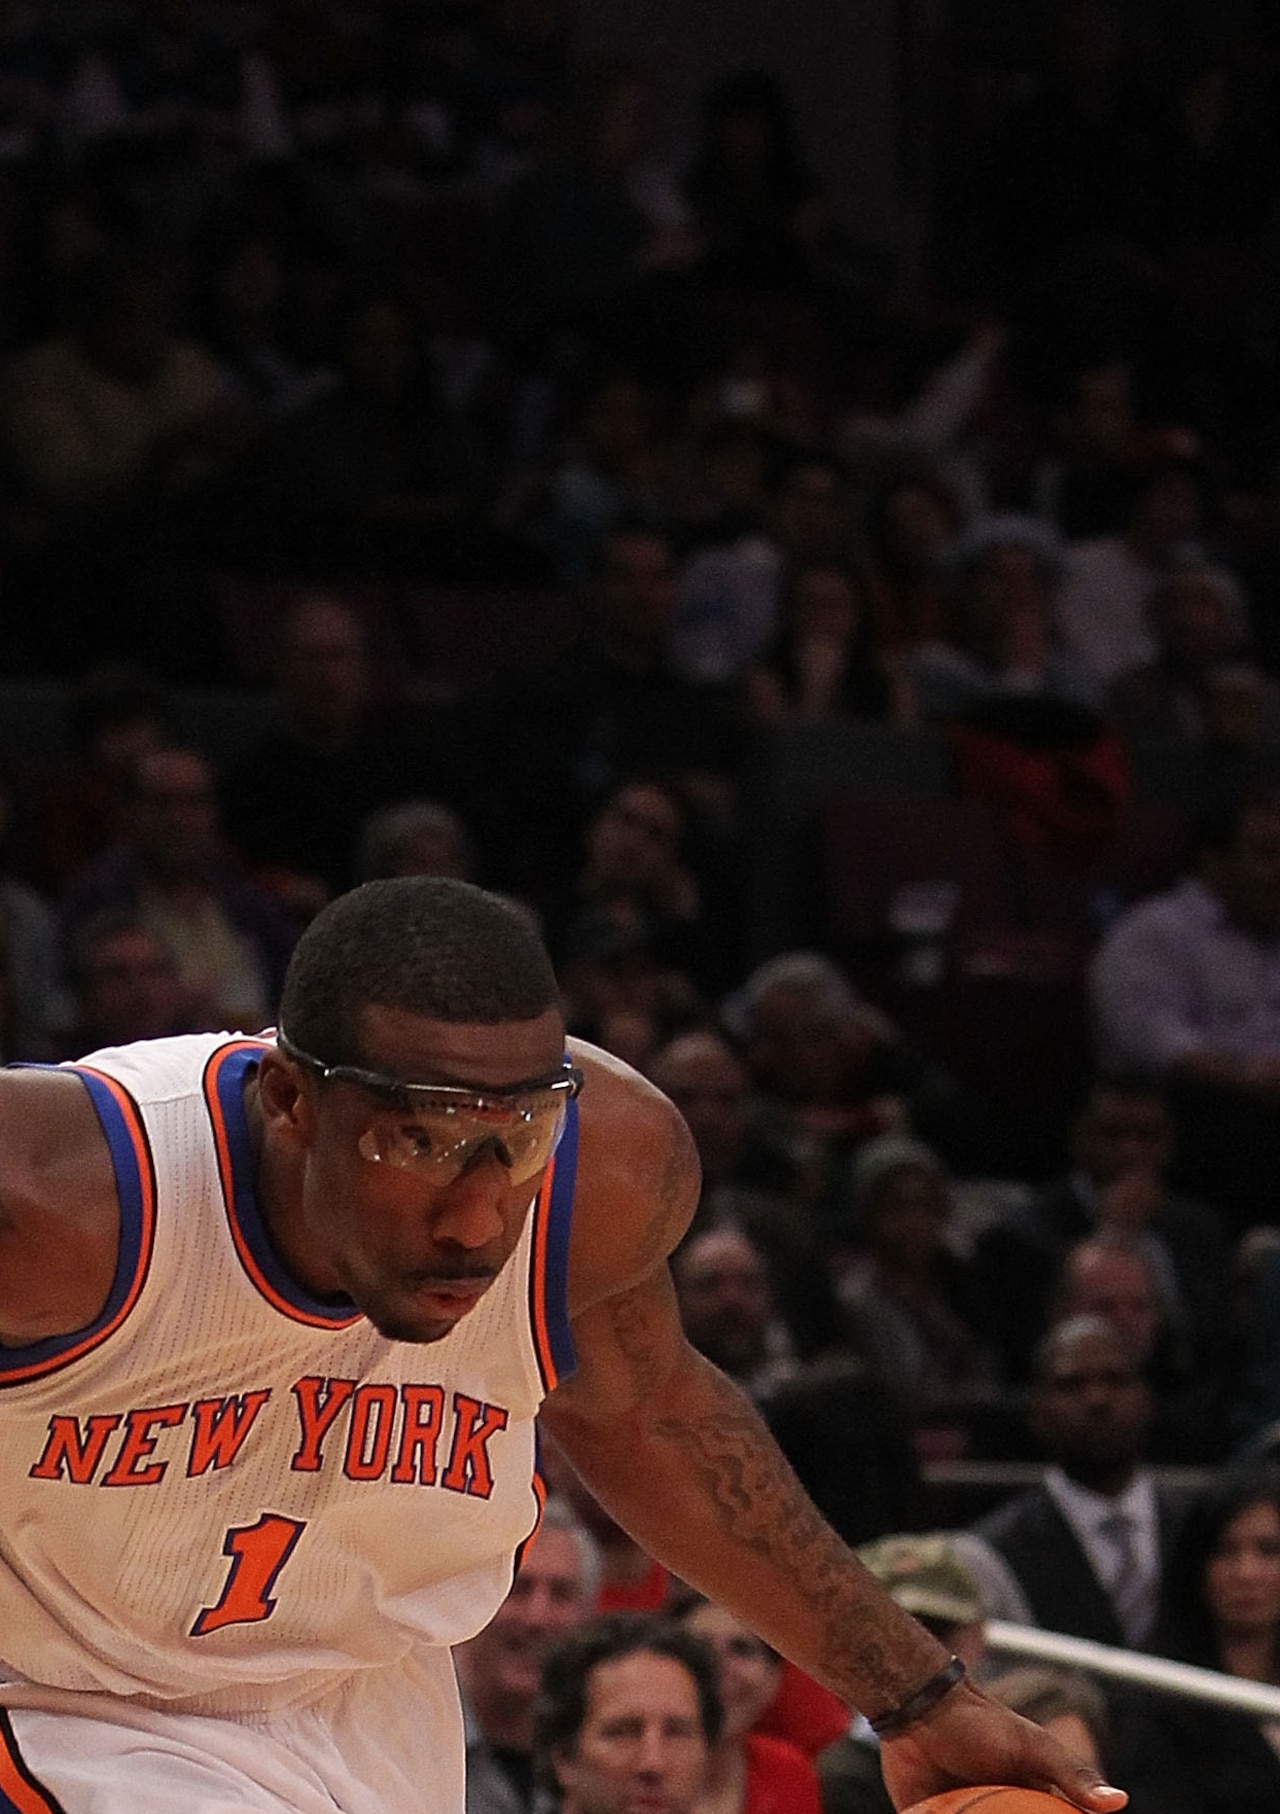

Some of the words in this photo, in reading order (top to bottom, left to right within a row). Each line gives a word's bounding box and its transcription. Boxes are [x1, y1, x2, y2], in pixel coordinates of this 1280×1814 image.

[30, 1388, 272, 1487] NEW
[291, 1376, 508, 1499] YORK
[189, 1512, 308, 1637] 1
